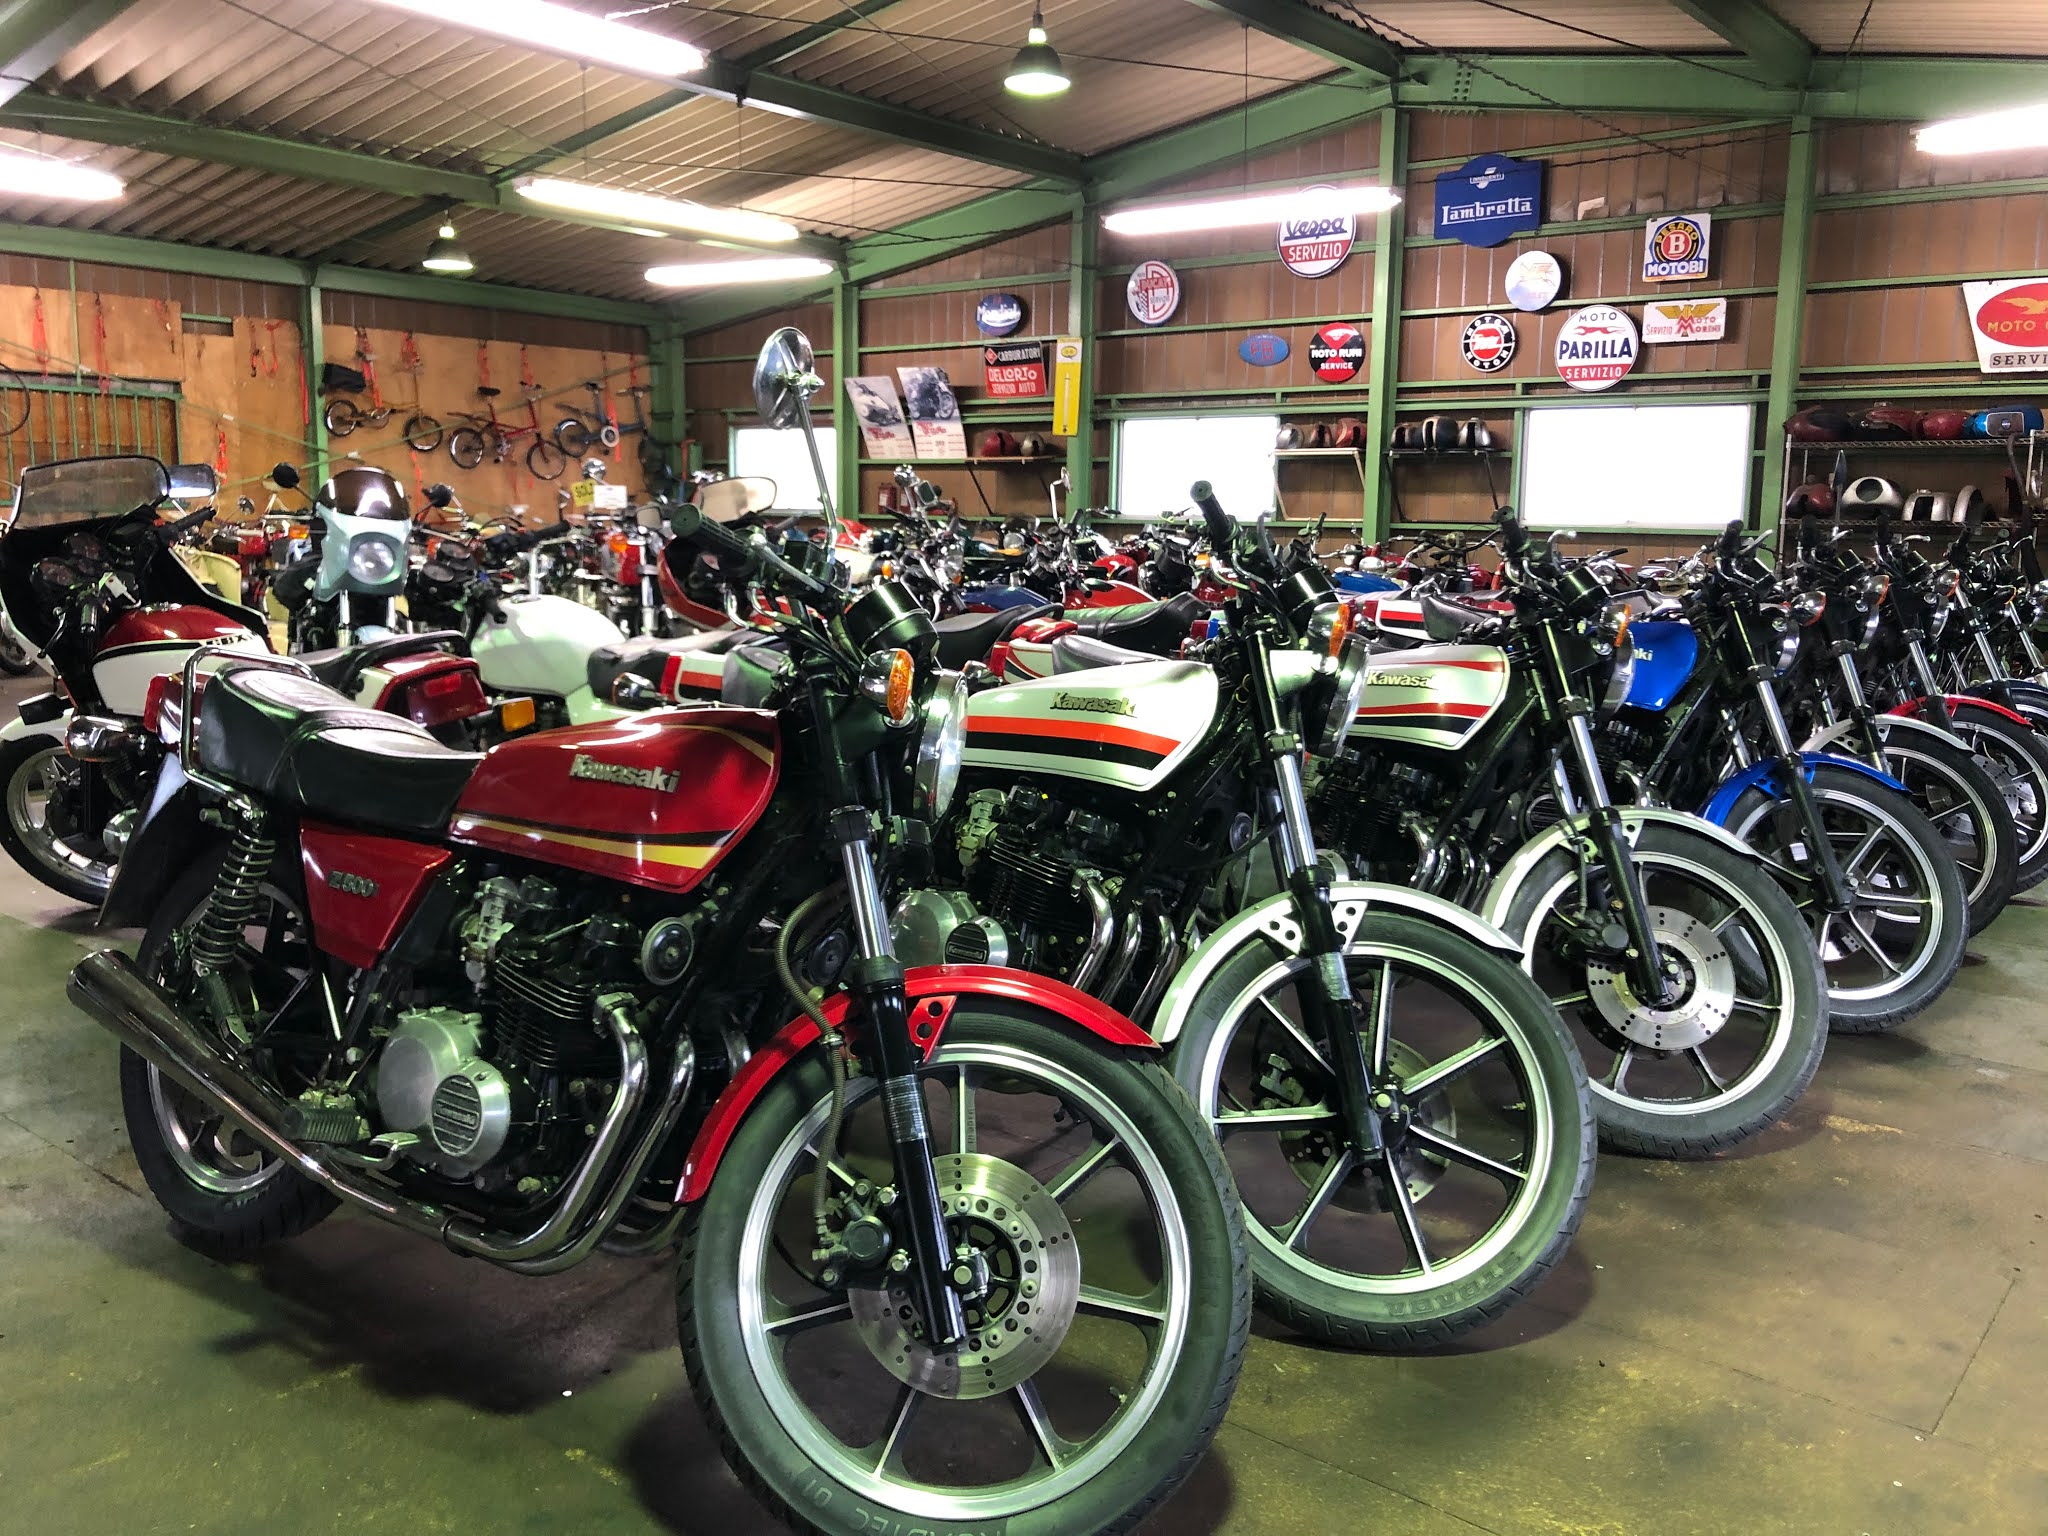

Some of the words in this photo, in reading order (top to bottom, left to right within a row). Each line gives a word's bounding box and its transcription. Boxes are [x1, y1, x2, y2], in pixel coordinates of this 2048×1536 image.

[1441, 198, 1532, 225] Lambretta
[1283, 217, 1348, 241] Vespa
[1656, 222, 1699, 244] PESARO
[1288, 242, 1342, 262] SERVIZIO
[1647, 260, 1704, 276] MOTOBI
[1578, 312, 1617, 322] MOTO
[1987, 320, 2036, 333] MOTO
[1311, 349, 1337, 358] MOTO
[1559, 337, 1632, 360] PARILLA
[1320, 362, 1353, 370] SERVICE
[1566, 366, 1622, 379] SERVIZIO
[1367, 668, 1438, 691] Kawasa
[569, 753, 680, 793] Kawasaki
